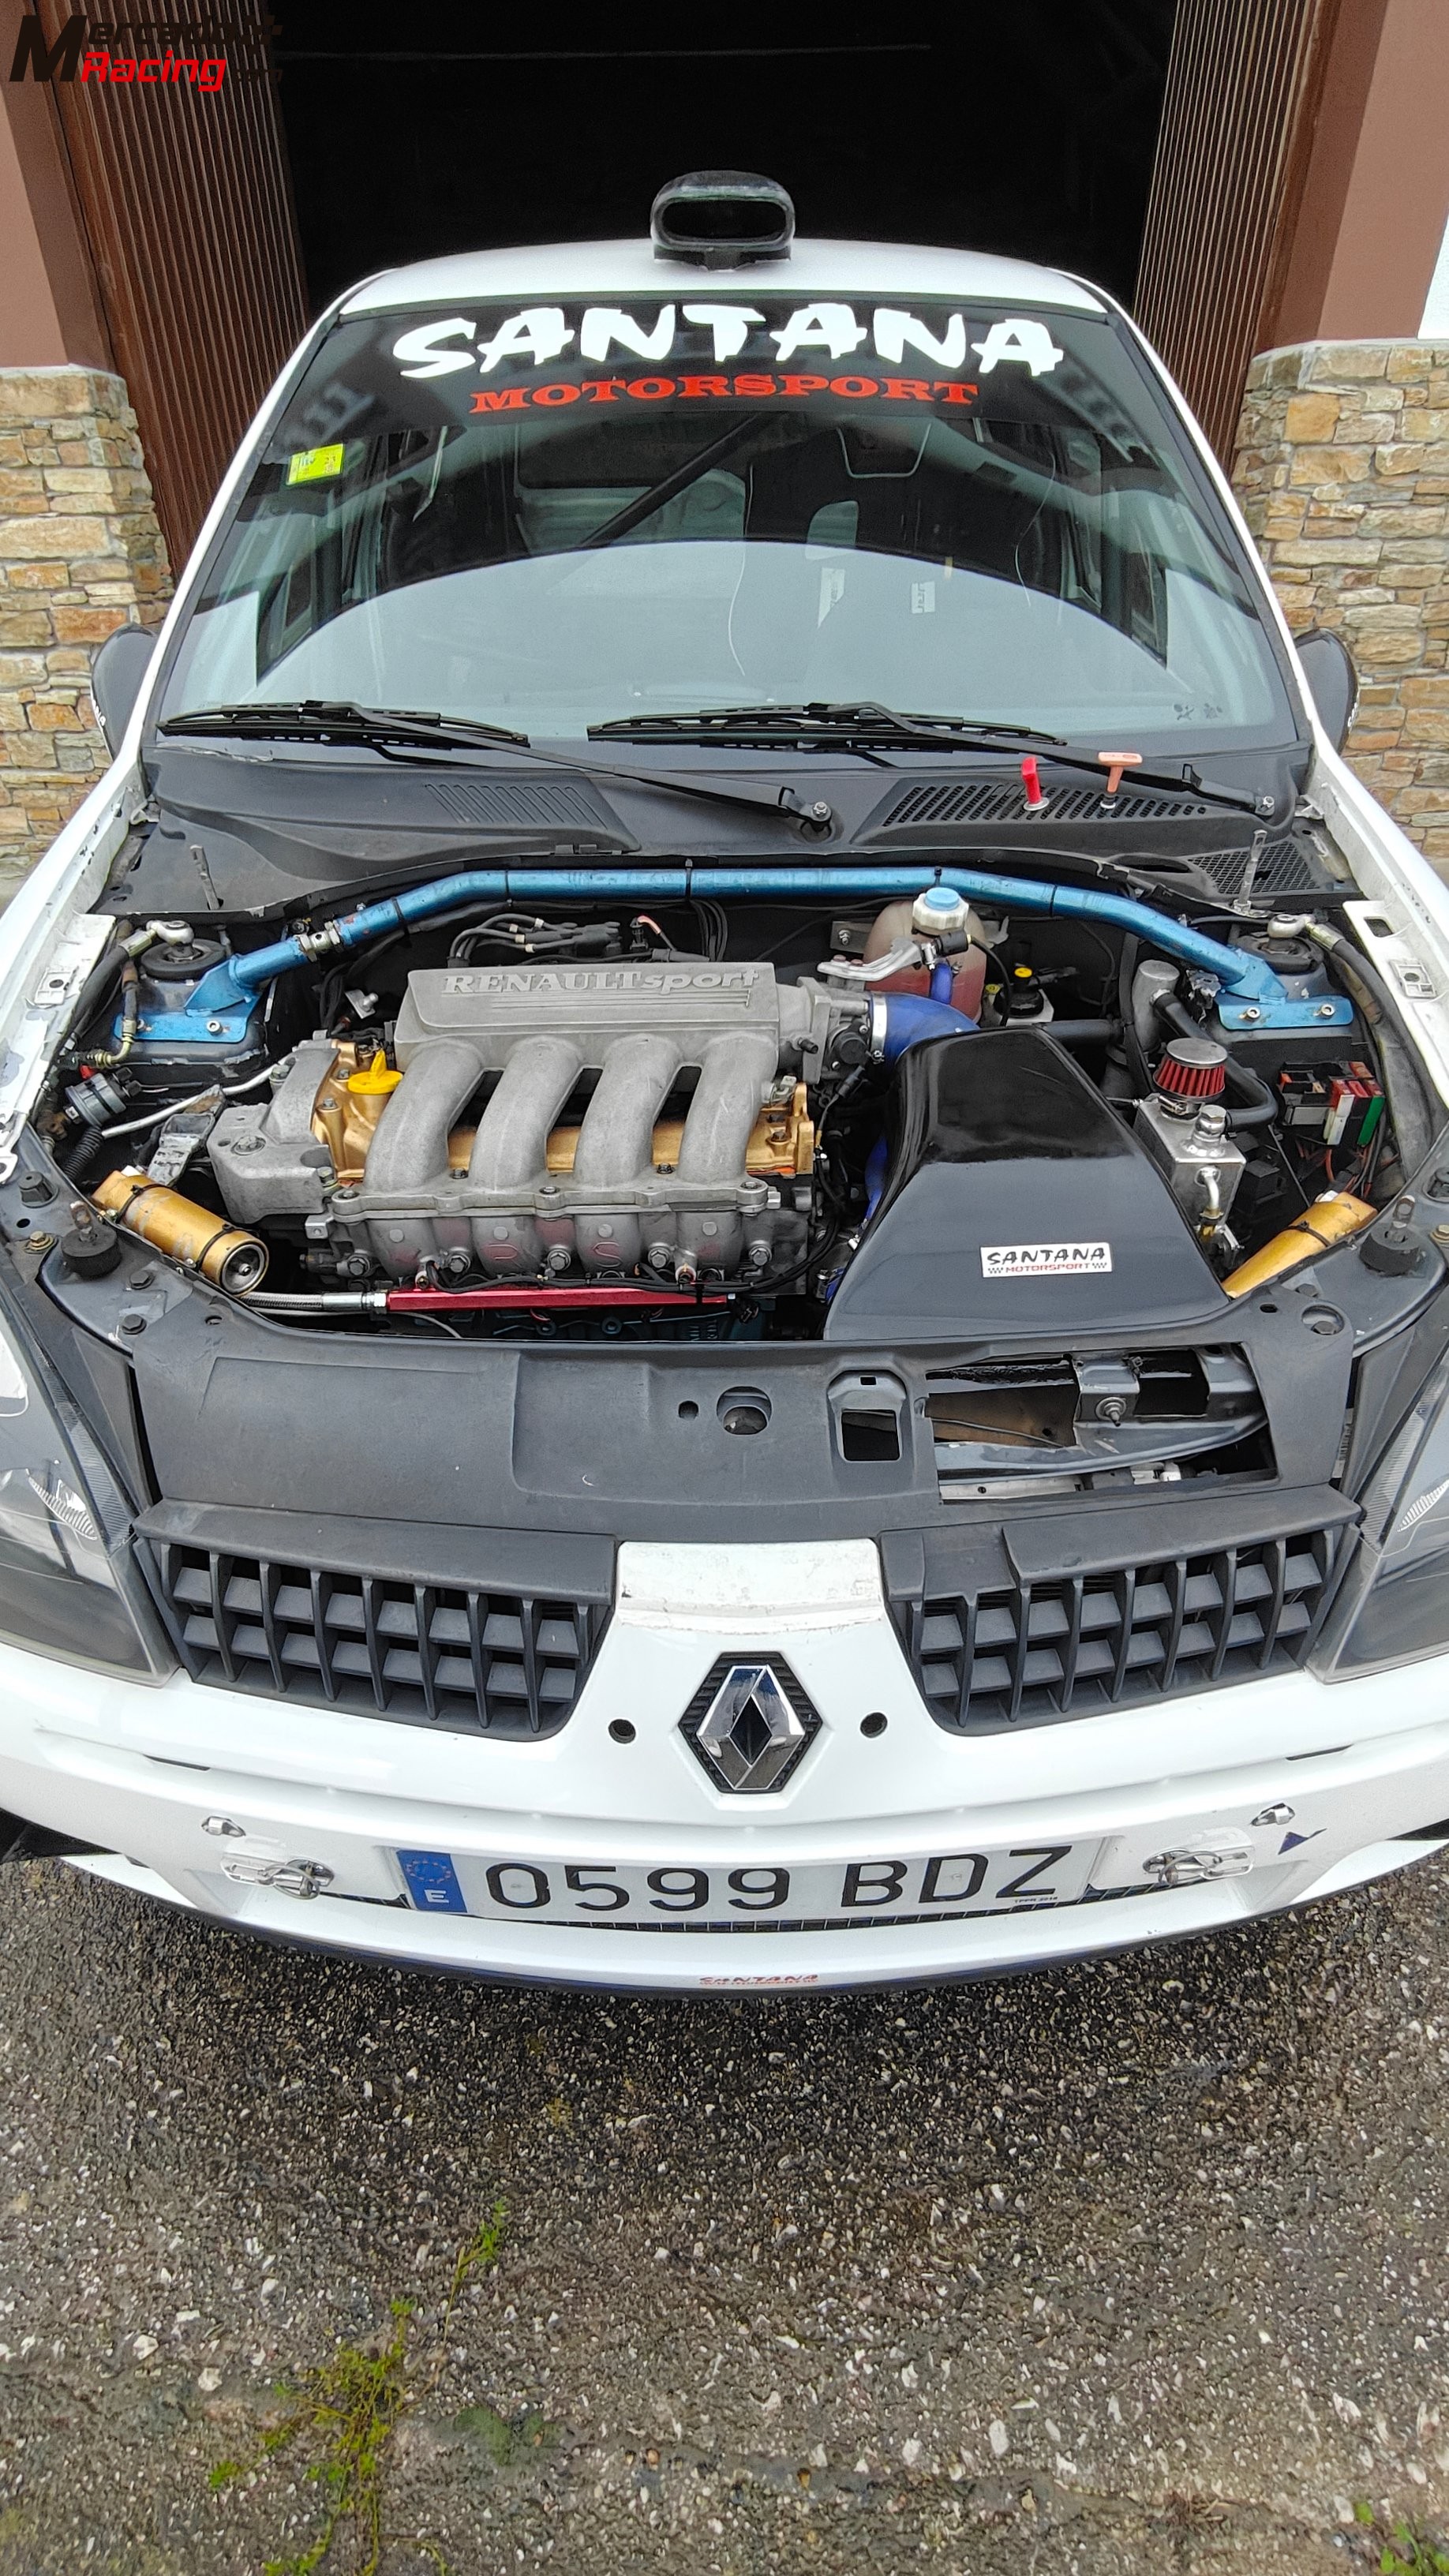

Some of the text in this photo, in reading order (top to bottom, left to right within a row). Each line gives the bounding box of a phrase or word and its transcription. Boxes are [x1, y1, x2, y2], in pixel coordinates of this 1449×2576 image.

[392, 302, 1065, 378] SANTANA
[469, 373, 979, 414] MOTORSPORT
[987, 1247, 1105, 1265] SANTANA
[1005, 1263, 1090, 1273] MOTORSPORT
[485, 1845, 1073, 1911] 0599 BDZ
[424, 1889, 449, 1904] E
